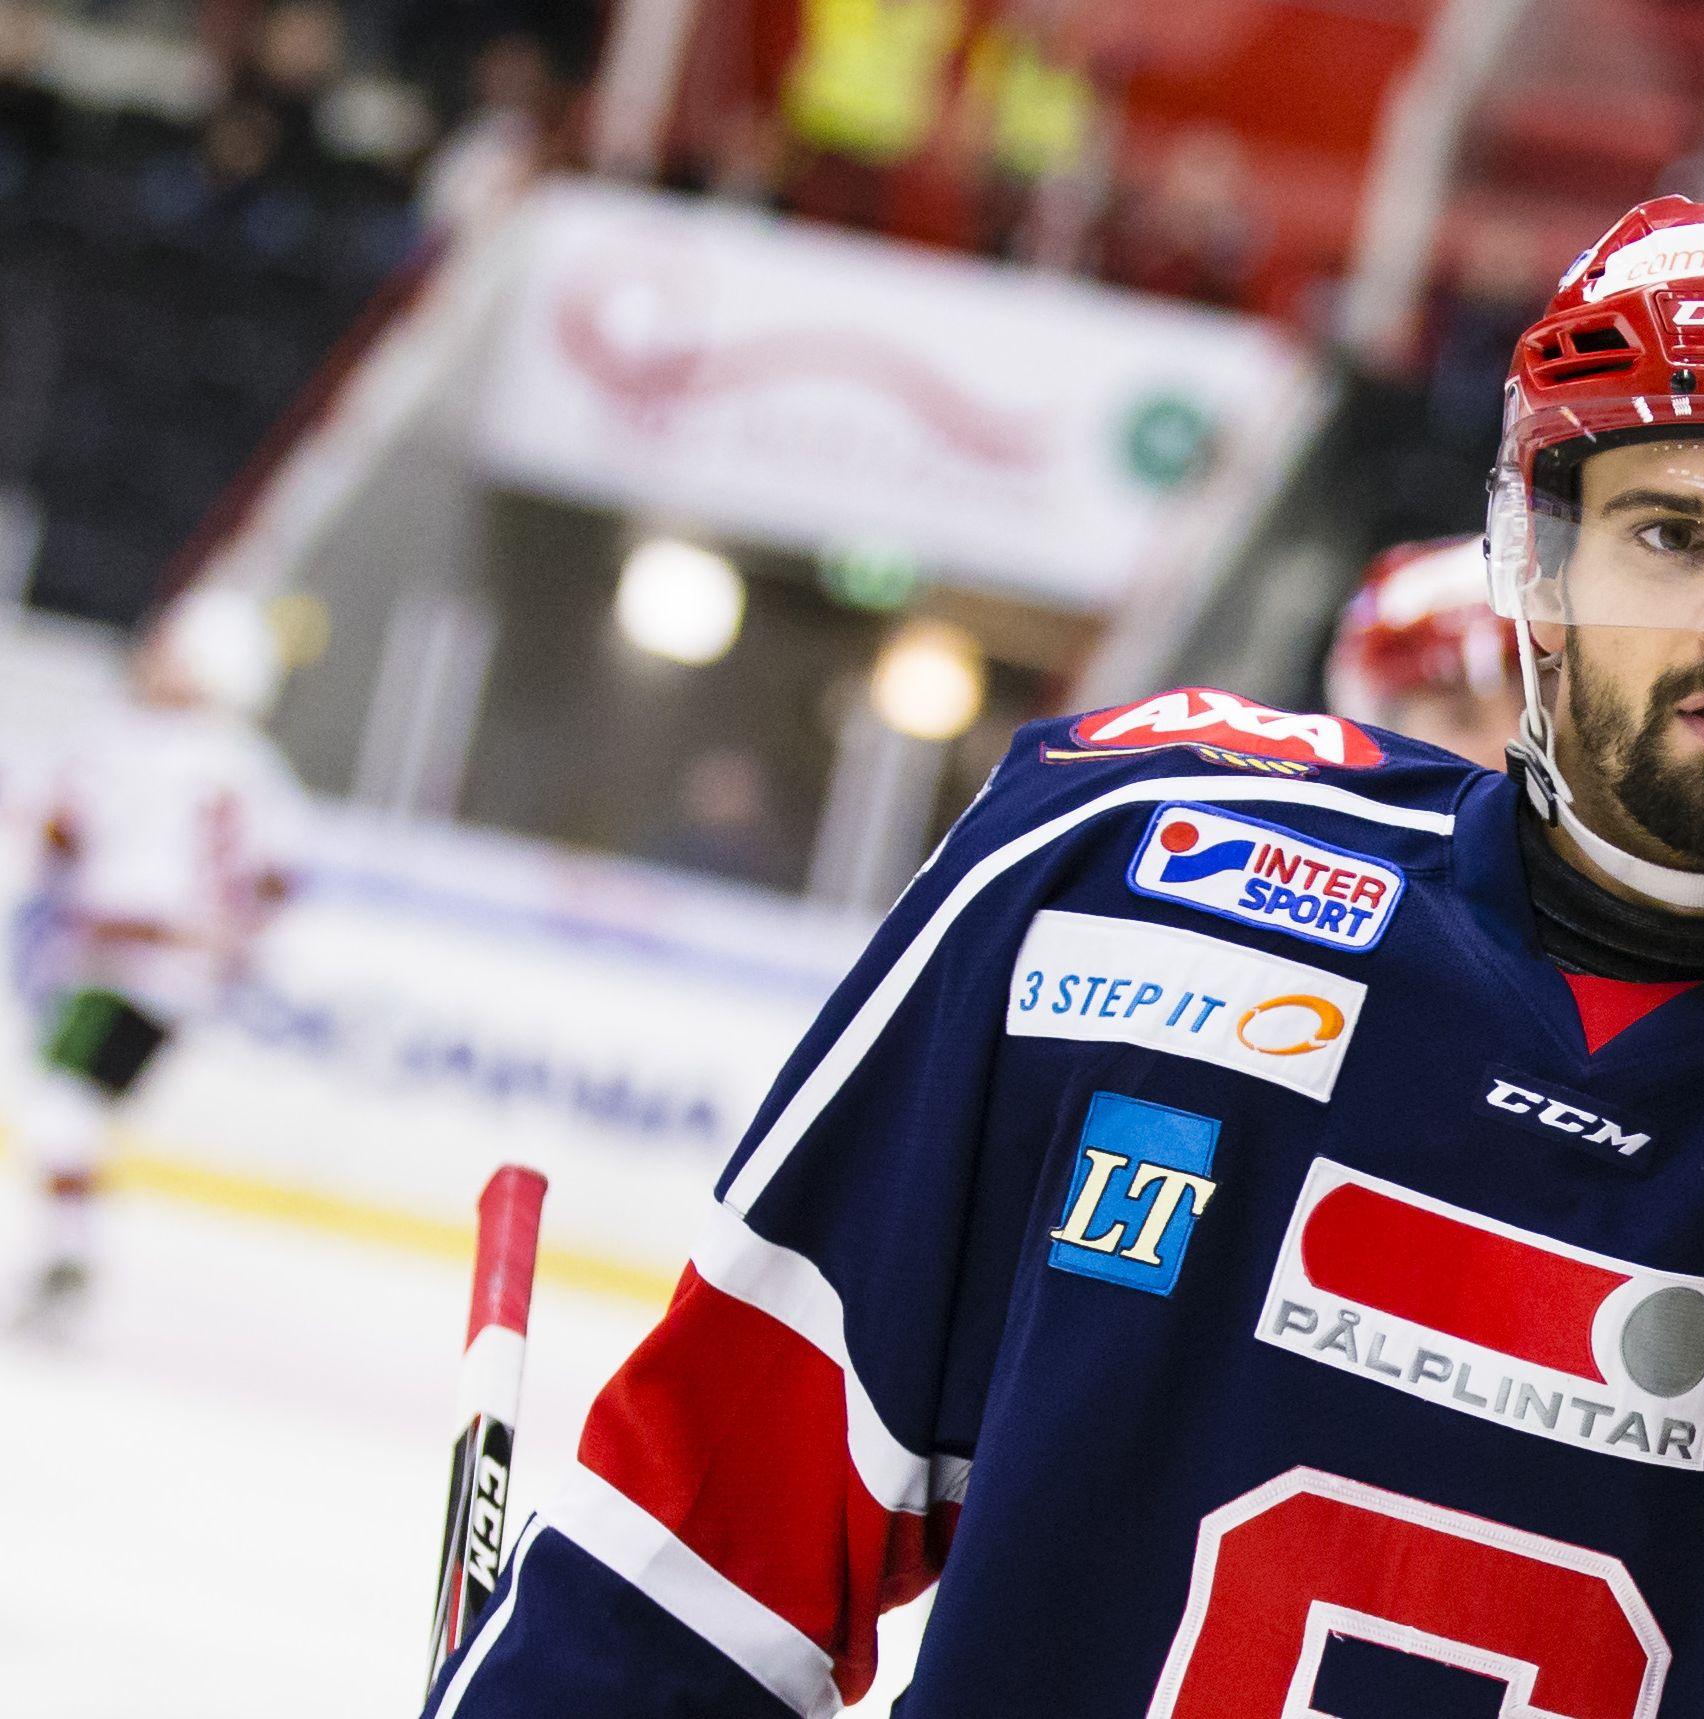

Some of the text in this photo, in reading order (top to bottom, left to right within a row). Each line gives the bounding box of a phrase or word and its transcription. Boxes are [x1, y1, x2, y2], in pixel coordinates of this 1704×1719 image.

[1090, 691, 1346, 764] AXA
[1238, 878, 1373, 939] SPORT
[1254, 842, 1388, 910] INTER
[1019, 970, 1227, 1034] 3 STEP IT
[1485, 1079, 1651, 1156] CCM
[1049, 1147, 1217, 1267] LT
[1271, 1299, 1699, 1461] PÅLPLINTAR
[469, 1454, 507, 1593] CCM
